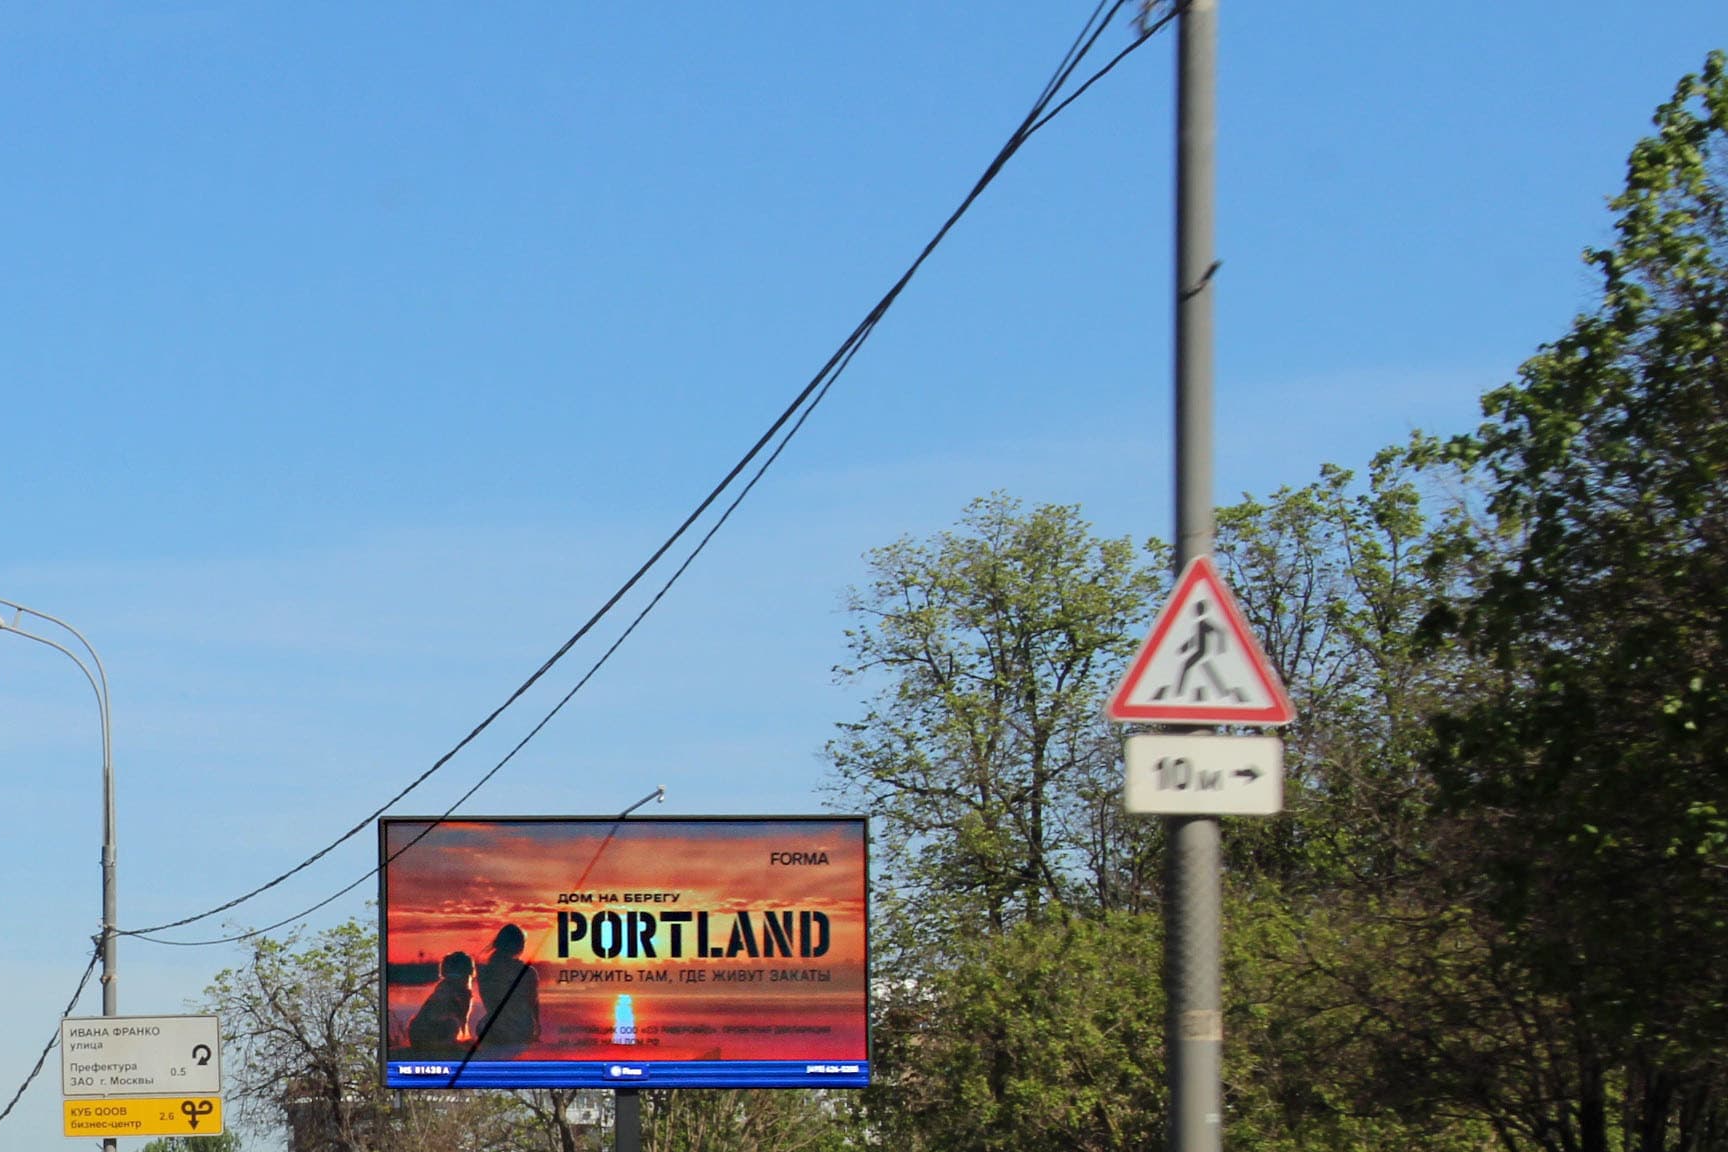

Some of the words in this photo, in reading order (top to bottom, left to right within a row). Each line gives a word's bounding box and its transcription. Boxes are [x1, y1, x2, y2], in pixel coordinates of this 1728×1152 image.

[1154, 756, 1192, 791] 10
[770, 852, 829, 866] FORMA
[557, 893, 592, 904] ДОМ
[599, 893, 619, 903] НА
[624, 893, 681, 903] БЕРЕГУ
[557, 910, 830, 959] PORTLAND
[557, 969, 633, 984] ДРУЖИТЬ
[638, 970, 672, 984] ТАМ,
[679, 969, 706, 983] ГДЕ
[712, 969, 764, 982] ЖИВУТ
[769, 969, 831, 983] ЗАКАТЫ
[70, 1028, 109, 1038] ИВАНА
[112, 1026, 160, 1037] ФРАНКО
[70, 1042, 103, 1051] улица
[70, 1062, 137, 1074] Префектура
[170, 1067, 187, 1077] 0.5
[70, 1077, 94, 1087] ЗАО
[110, 1076, 154, 1086] Москвы
[71, 1107, 92, 1116] КУБ
[71, 1119, 142, 1129] бизнес-центр
